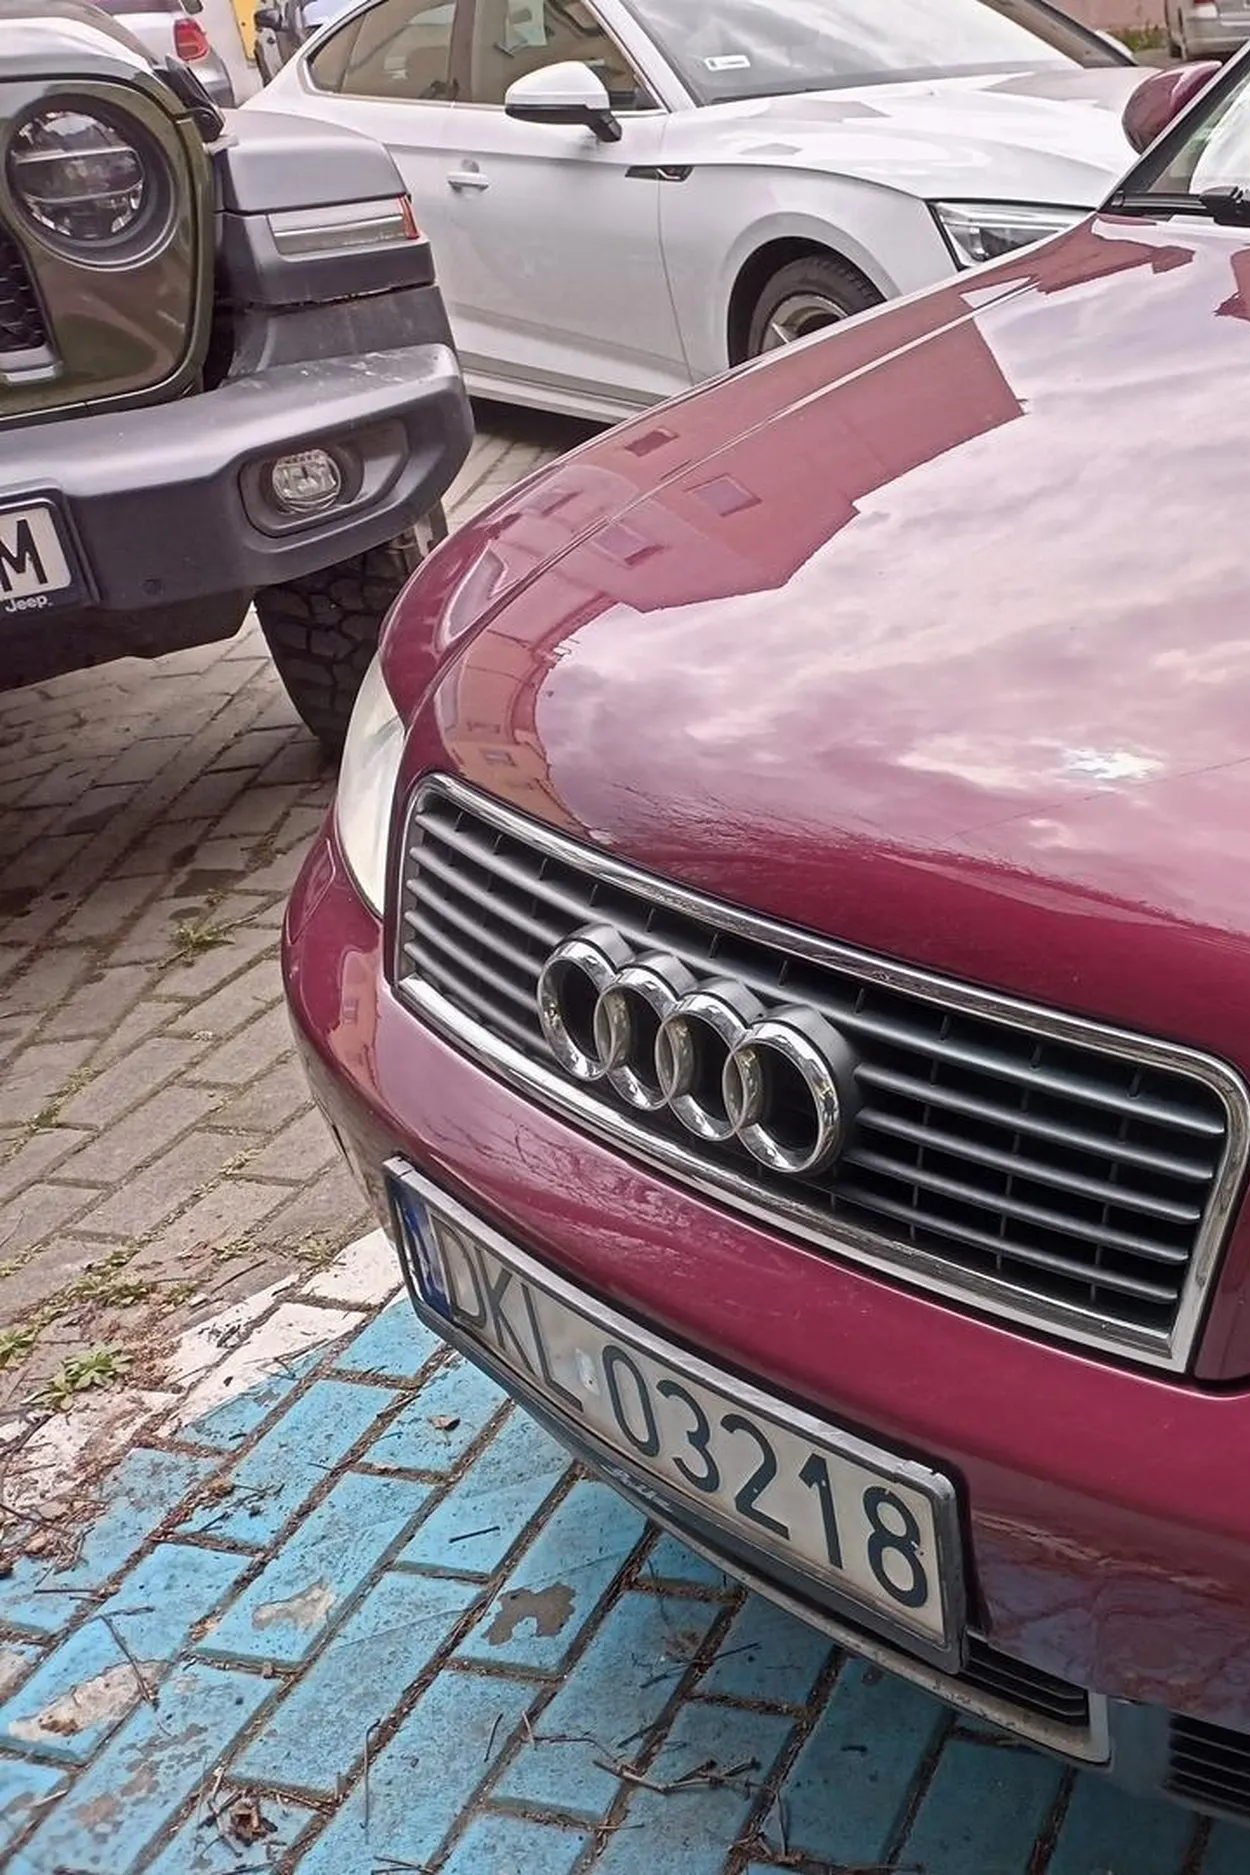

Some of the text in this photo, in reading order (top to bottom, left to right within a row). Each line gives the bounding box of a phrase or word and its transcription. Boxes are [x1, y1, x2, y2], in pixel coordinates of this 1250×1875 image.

[5, 596, 49, 613] Jeep
[431, 1213, 930, 1609] DKL 03218
